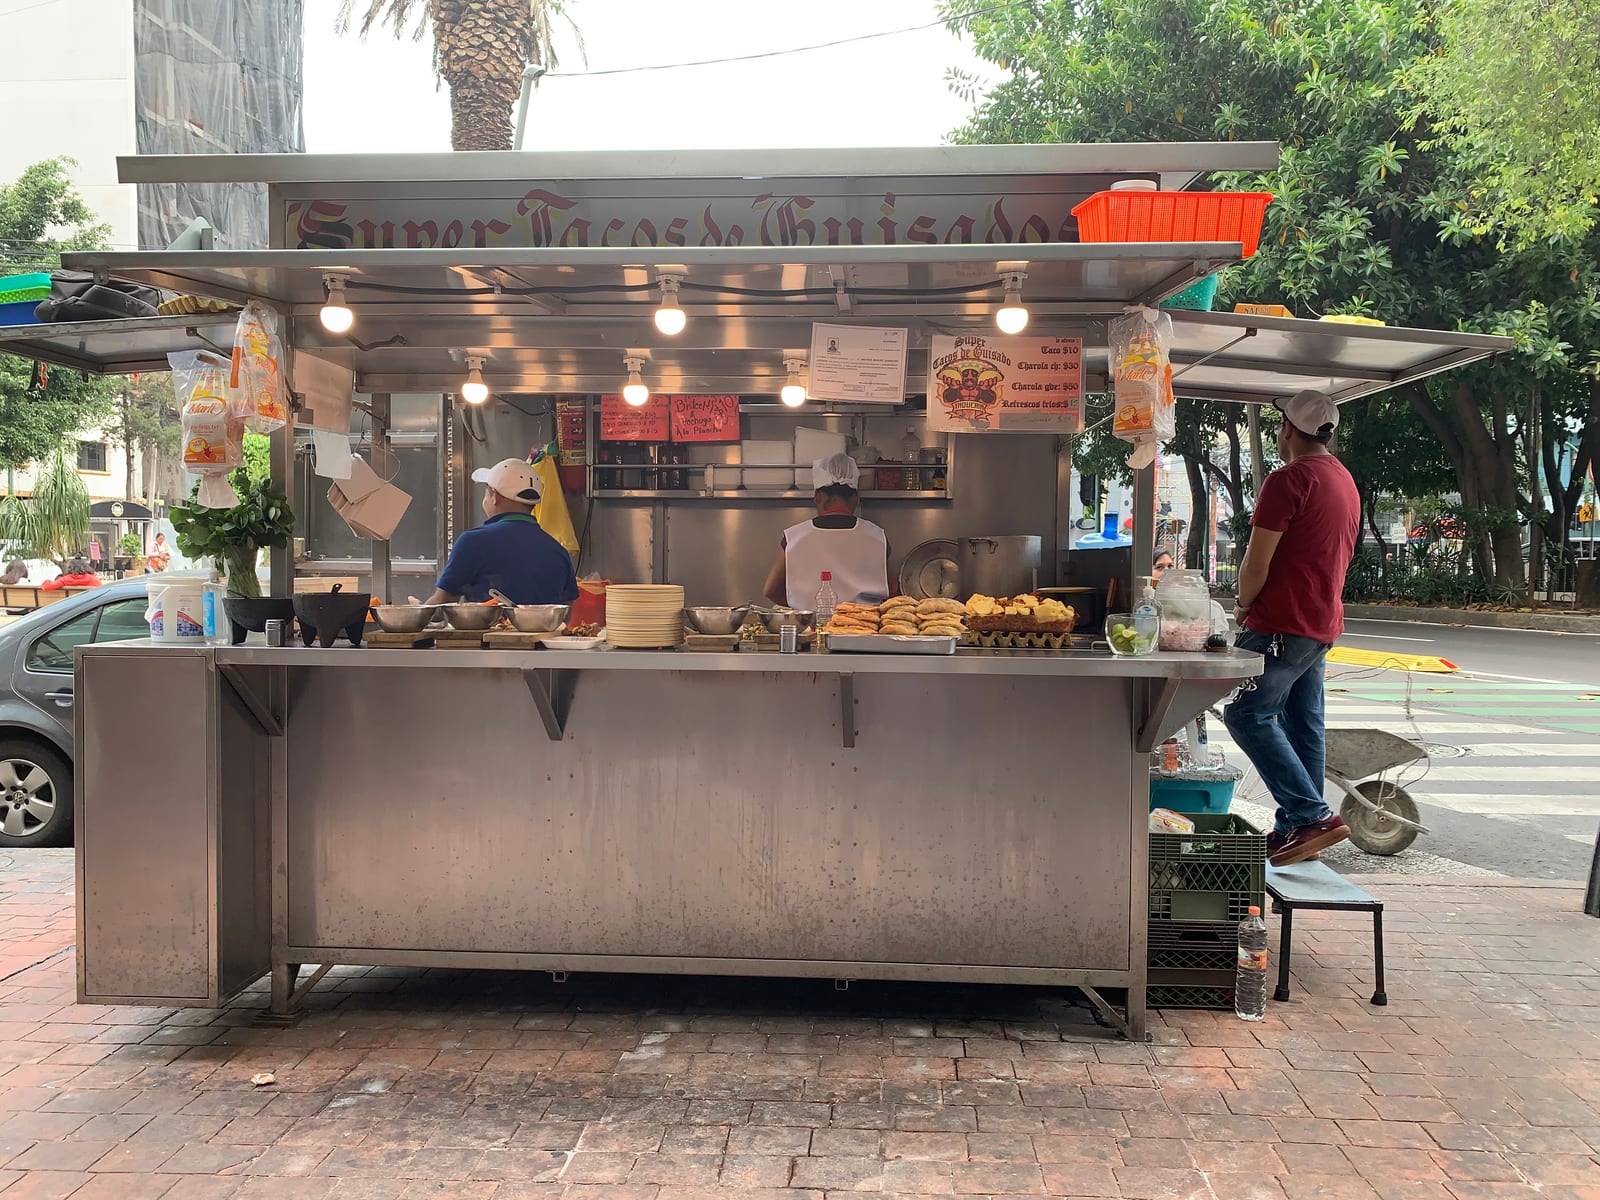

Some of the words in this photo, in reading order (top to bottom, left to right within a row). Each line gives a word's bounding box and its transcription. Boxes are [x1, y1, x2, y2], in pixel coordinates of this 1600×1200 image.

[286, 200, 512, 248] Super
[516, 188, 689, 248] Tacos
[699, 203, 744, 247] de
[954, 336, 986, 349] Super
[1041, 346, 1061, 354] Taco
[1062, 346, 1079, 355] $10
[933, 349, 958, 369] Tacos
[960, 347, 970, 359] de
[973, 346, 1012, 366] Guisado
[1017, 361, 1048, 371] Charola
[1011, 382, 1042, 391] Charola
[1001, 400, 1041, 408] Refrescos
